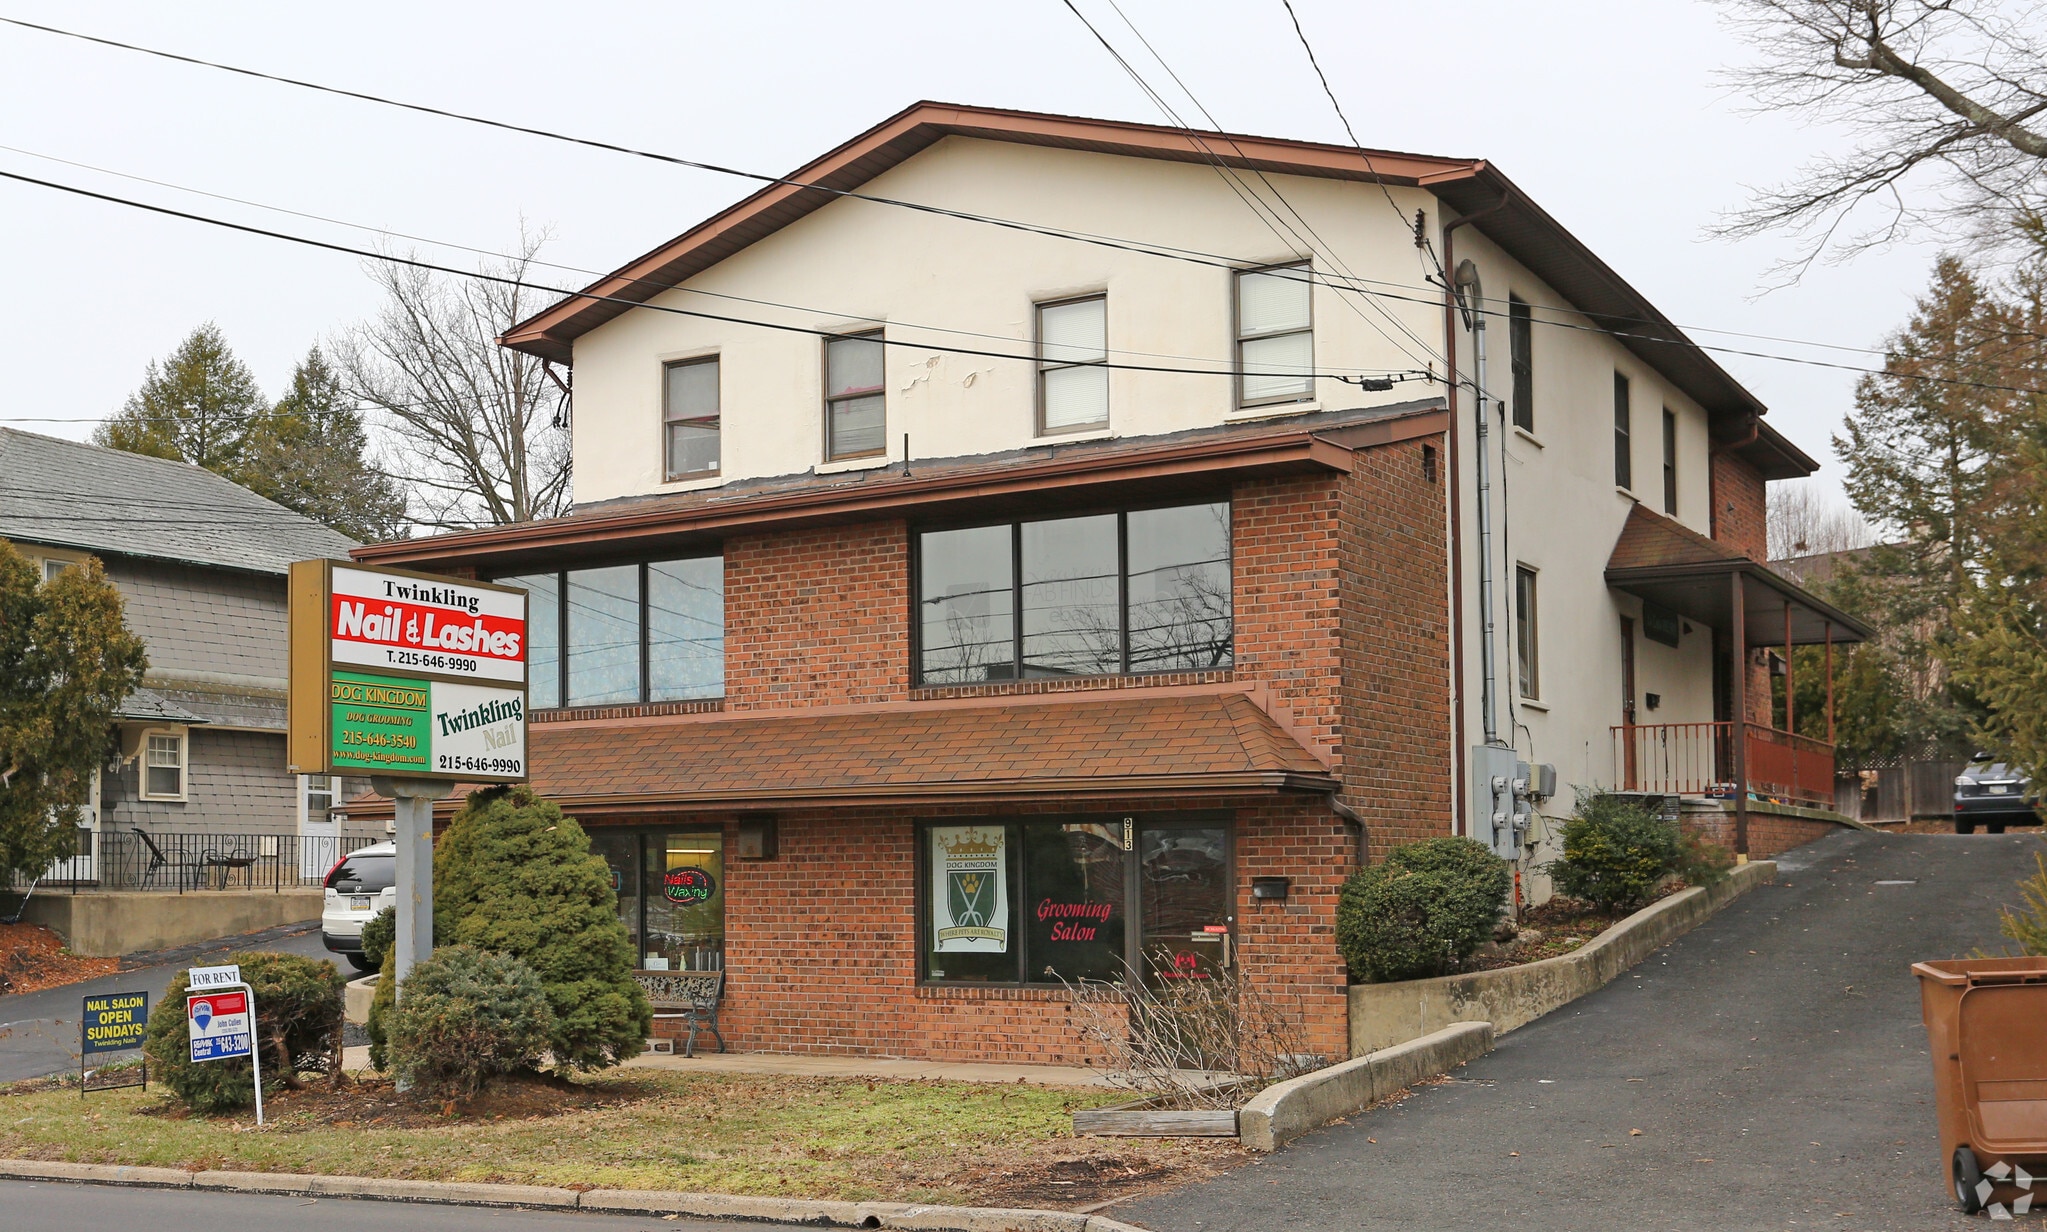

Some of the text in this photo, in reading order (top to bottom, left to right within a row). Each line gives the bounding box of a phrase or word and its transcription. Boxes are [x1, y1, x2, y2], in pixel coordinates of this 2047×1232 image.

[383, 579, 480, 614] Twinkling
[337, 600, 521, 658] Nail & Lashes
[398, 650, 477, 672] 215-646-9990
[331, 684, 427, 707] DOG KINGDOM
[346, 711, 413, 727] DOG GROOMING
[437, 695, 523, 737] Twinkling
[342, 729, 416, 749] 215-646-3540
[482, 722, 517, 752] Nail
[332, 749, 426, 765] www.dog-kingdom.com
[439, 754, 521, 774] 215-646-9990
[946, 861, 998, 869] DOG KINGDOM
[663, 874, 694, 885] Nails
[667, 886, 708, 900] Waxing
[1037, 897, 1113, 923] Grooming
[1050, 920, 1097, 941] Salon
[192, 971, 237, 985] FOR RENT
[86, 996, 144, 1012] NAIL SALON
[98, 1009, 132, 1025] OPEN
[87, 1022, 143, 1040] SUNDAYS
[94, 1039, 122, 1047] Twinkling
